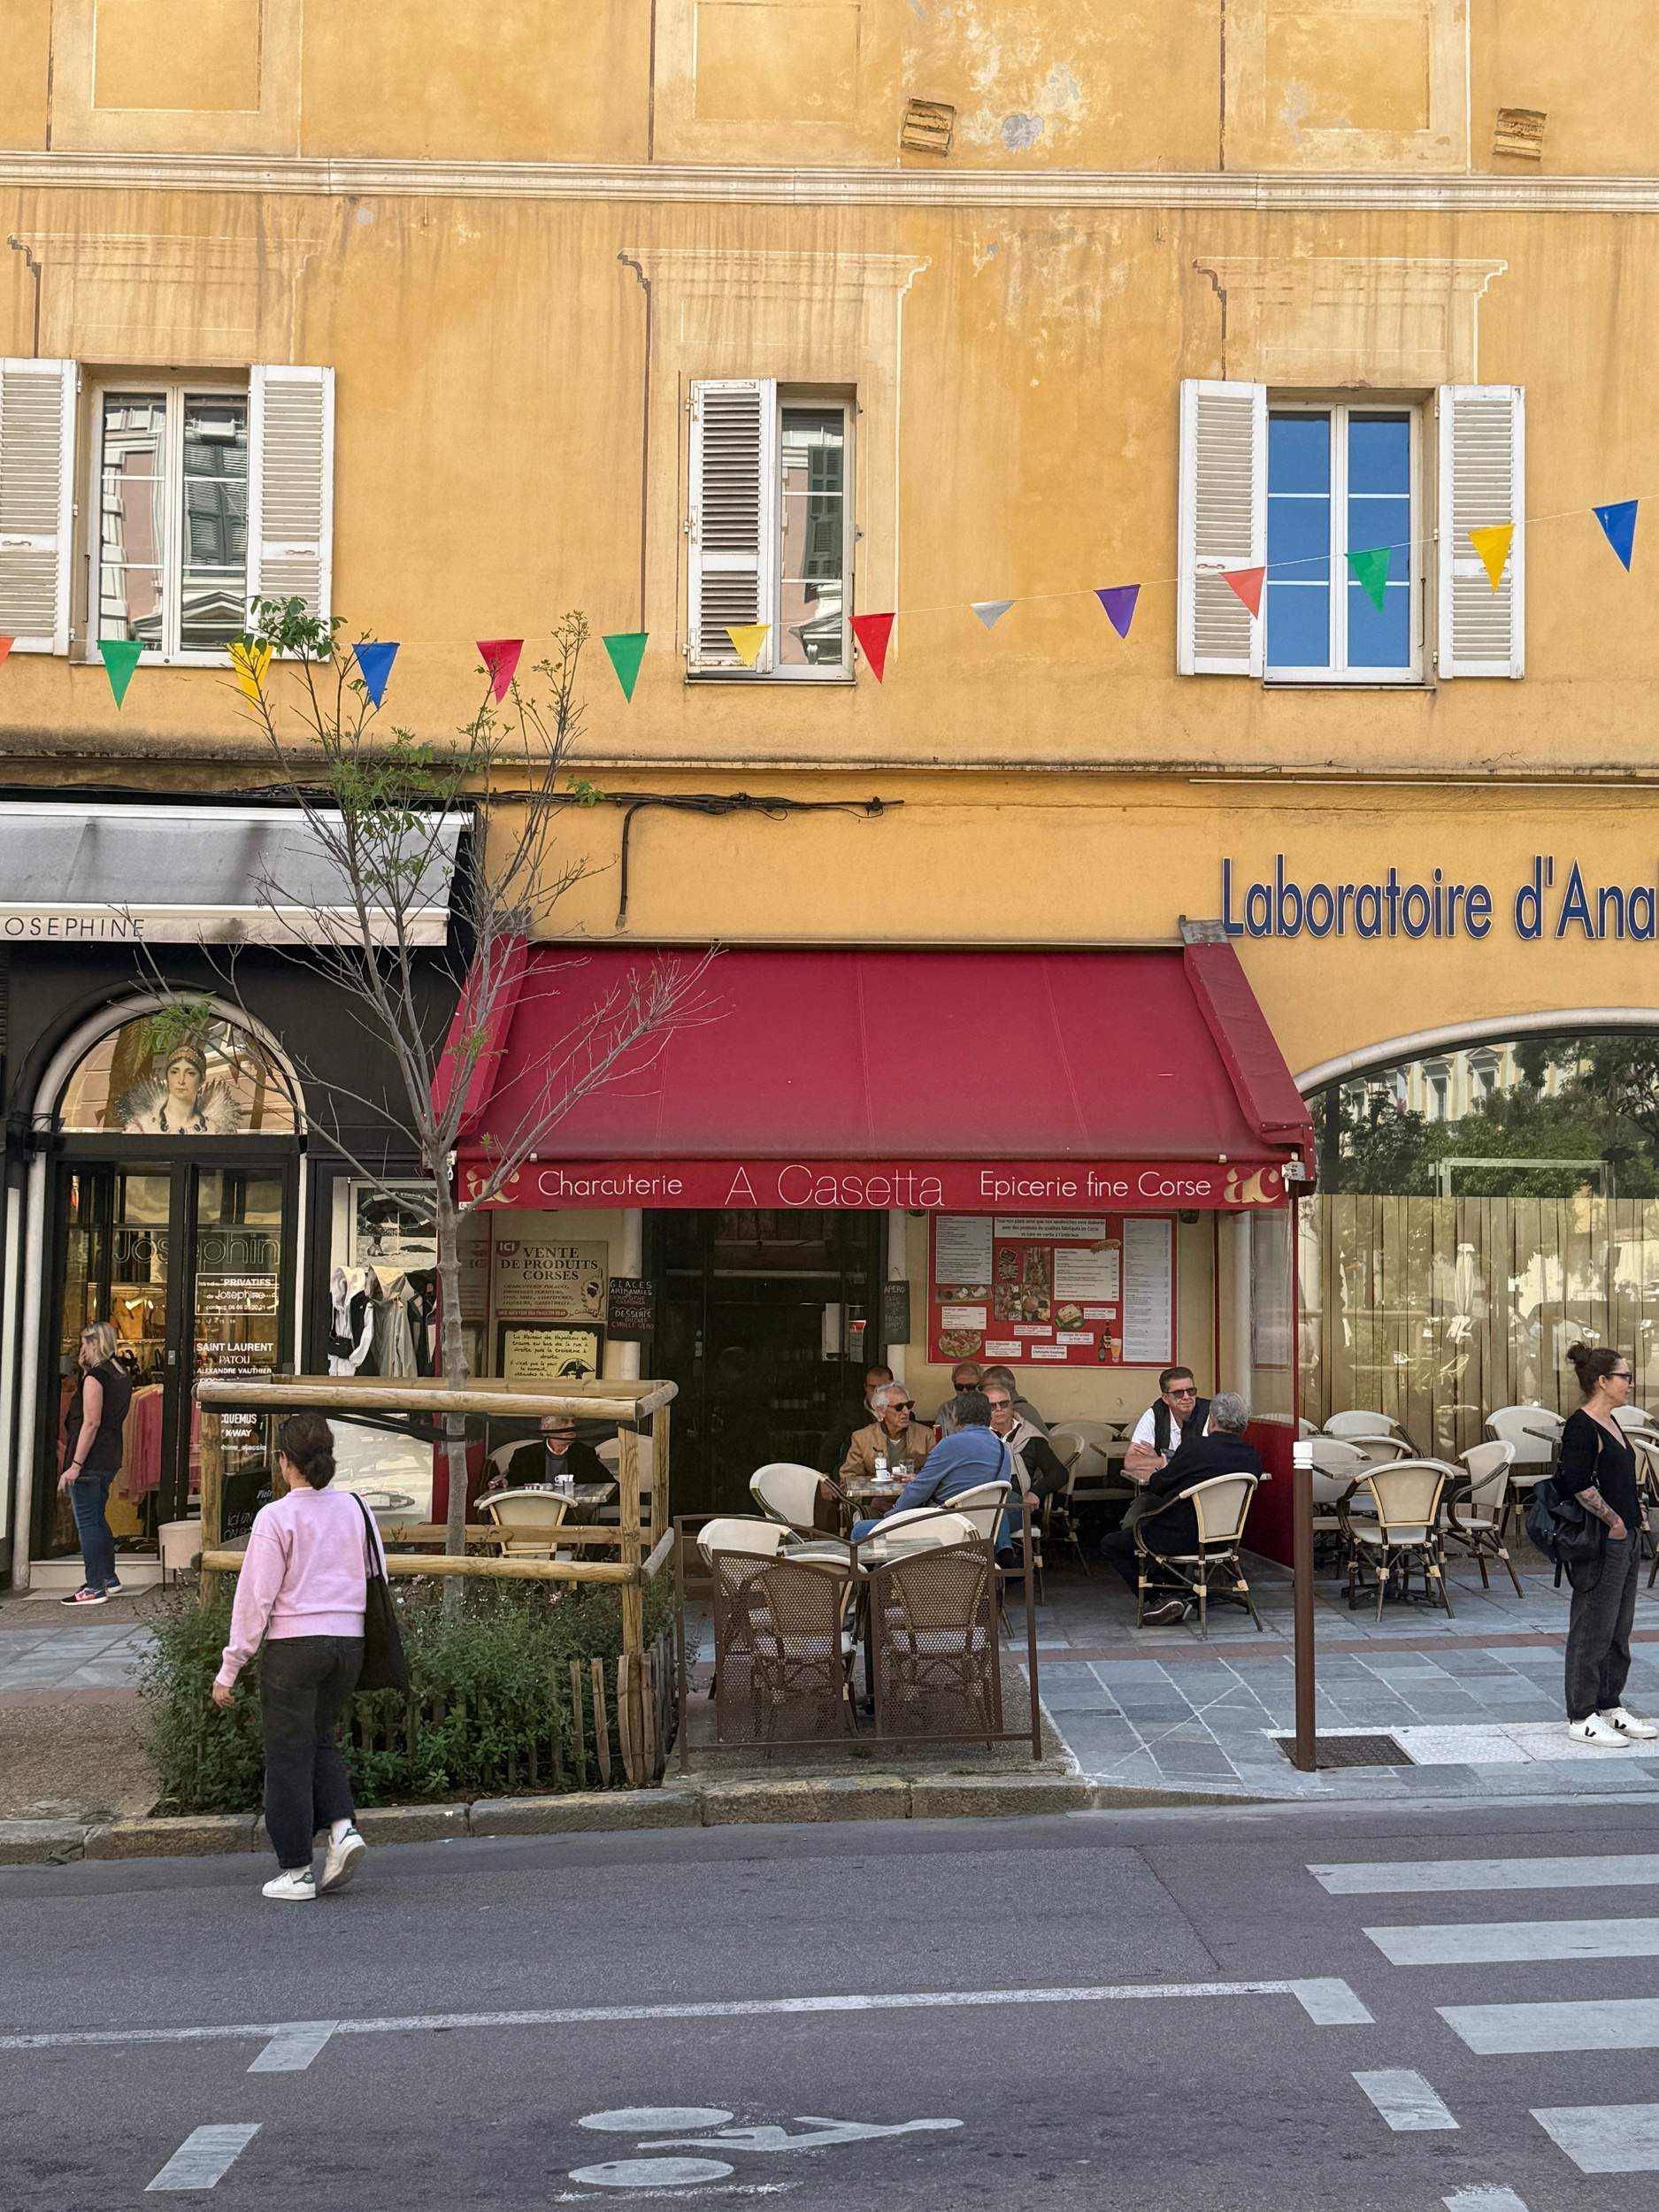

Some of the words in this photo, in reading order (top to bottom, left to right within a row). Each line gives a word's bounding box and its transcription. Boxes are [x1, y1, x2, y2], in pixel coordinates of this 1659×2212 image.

[1222, 853, 1494, 939] Laboratoire
[1515, 855, 1659, 941] d'Ana
[538, 1170, 683, 1195] Charcuterie
[724, 1166, 757, 1205] A
[778, 1164, 945, 1207] Casetta
[980, 1171, 1077, 1202] Epicerie
[1087, 1171, 1129, 1197] fine
[1138, 1171, 1211, 1197] Corse
[499, 1242, 515, 1252] ICI
[523, 1247, 580, 1259] VENTE
[501, 1259, 520, 1269] DE
[524, 1259, 598, 1270] PRODUITS
[523, 1270, 580, 1280] CORSES
[610, 1279, 652, 1289] GLACES
[196, 1343, 226, 1352] SAINT
[227, 1343, 274, 1352] LAURENT
[219, 1356, 250, 1364] PATOU
